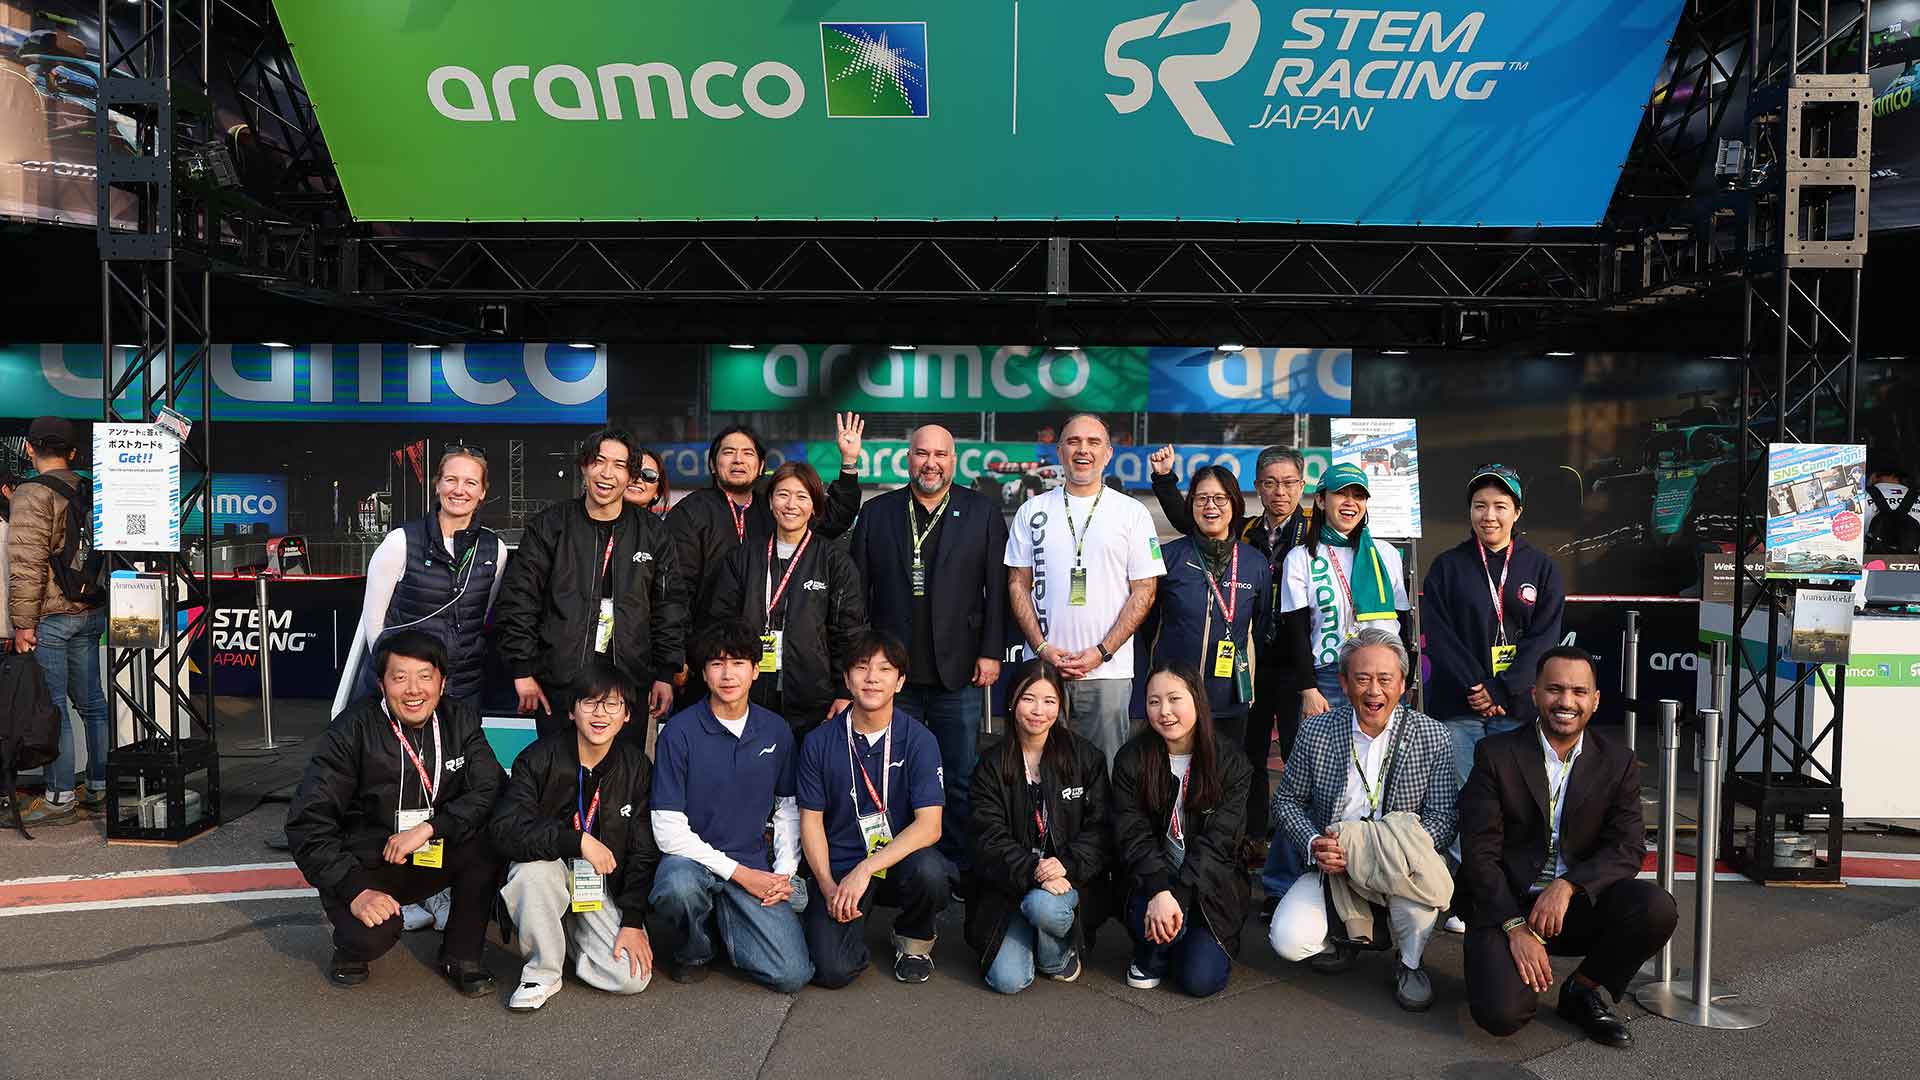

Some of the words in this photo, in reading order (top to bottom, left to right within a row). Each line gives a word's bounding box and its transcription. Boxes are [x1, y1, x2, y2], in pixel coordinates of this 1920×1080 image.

[1282, 8, 1486, 54] STEM
[1264, 57, 1505, 100] RACING
[427, 61, 805, 121] aramco
[1248, 104, 1373, 131] JAPAN
[763, 344, 1090, 399] aramco
[118, 452, 153, 464] Get!!
[1772, 465, 1800, 481] SNS
[1801, 448, 1863, 473] Campaign!
[1754, 563, 1765, 571] to
[1222, 581, 1252, 590] armco
[212, 608, 293, 629] STEM
[1311, 555, 1341, 666] aramco
[212, 630, 306, 652] RACNG
[213, 653, 257, 667] APAN
[1650, 652, 1698, 671] ara
